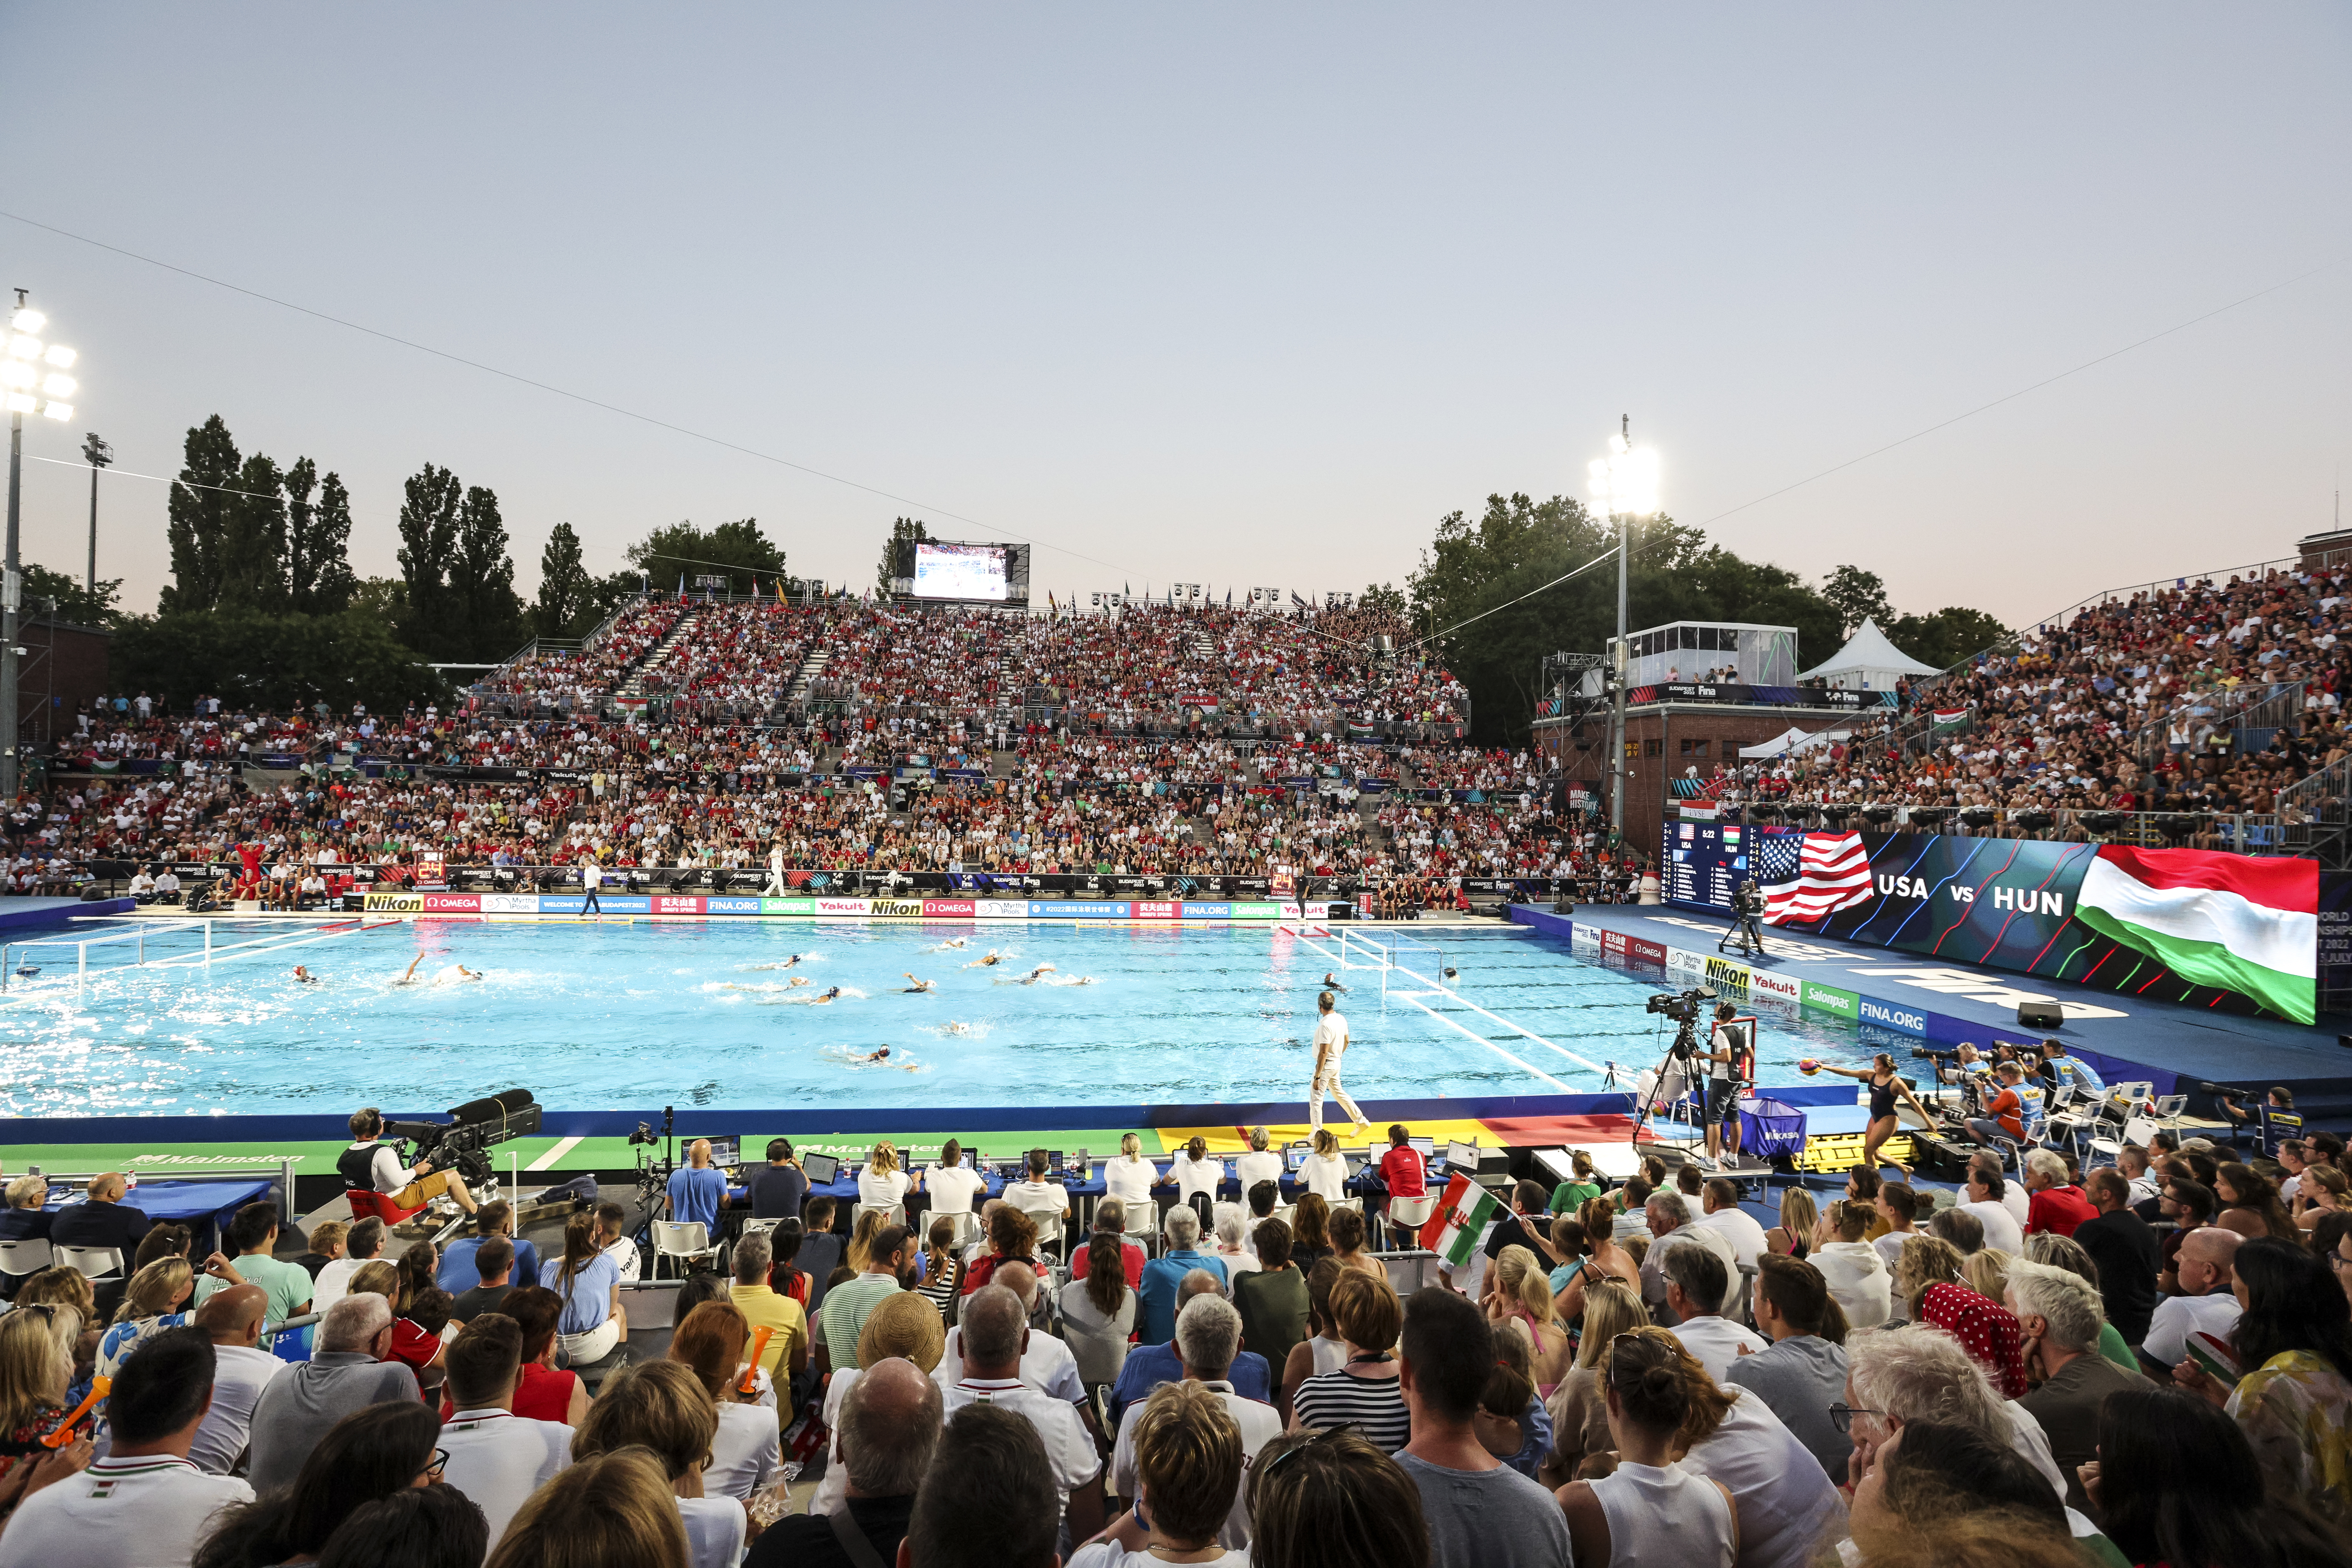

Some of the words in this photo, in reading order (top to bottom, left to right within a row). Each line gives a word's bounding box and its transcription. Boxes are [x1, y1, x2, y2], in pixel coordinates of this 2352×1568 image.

[1699, 685, 1716, 695] Fina
[1843, 692, 1859, 701] Fina
[1570, 790, 1590, 799] MAKE
[1570, 800, 1597, 810] HISTORY
[1702, 830, 1714, 839] 5:22
[1679, 851, 1684, 861] 8
[1734, 857, 1739, 867] 4
[419, 862, 441, 877] 24
[632, 871, 650, 881] Fina
[1274, 874, 1292, 888] 24
[1496, 880, 1509, 889] Fina
[1879, 874, 1928, 899] USA
[1995, 887, 2063, 917] HUN
[367, 896, 421, 910] Nikon
[661, 898, 697, 907] 农夫山泉
[710, 901, 758, 911] FINA.ORG
[765, 900, 810, 911] Salonpas
[1140, 903, 1172, 912] 农夫山泉
[871, 902, 920, 915] Nikon
[1184, 906, 1228, 915] FINA.ORG
[1235, 905, 1276, 915] Salonpas
[1590, 929, 1600, 941] Fina
[1605, 932, 1626, 947] 农夫山泉
[1605, 942, 1615, 951] NONGFU
[1642, 946, 1661, 958] OMEGA
[1686, 954, 1701, 964] Myrtha
[1685, 961, 1697, 970] Pools
[1706, 959, 1749, 987] Nikon
[1755, 975, 1797, 996] Yakult
[1807, 987, 1850, 1009] Salonpas
[1861, 1002, 1924, 1031] FINA.ORG
[823, 1144, 945, 1153] Malsten
[165, 1154, 305, 1165] Malmsten
